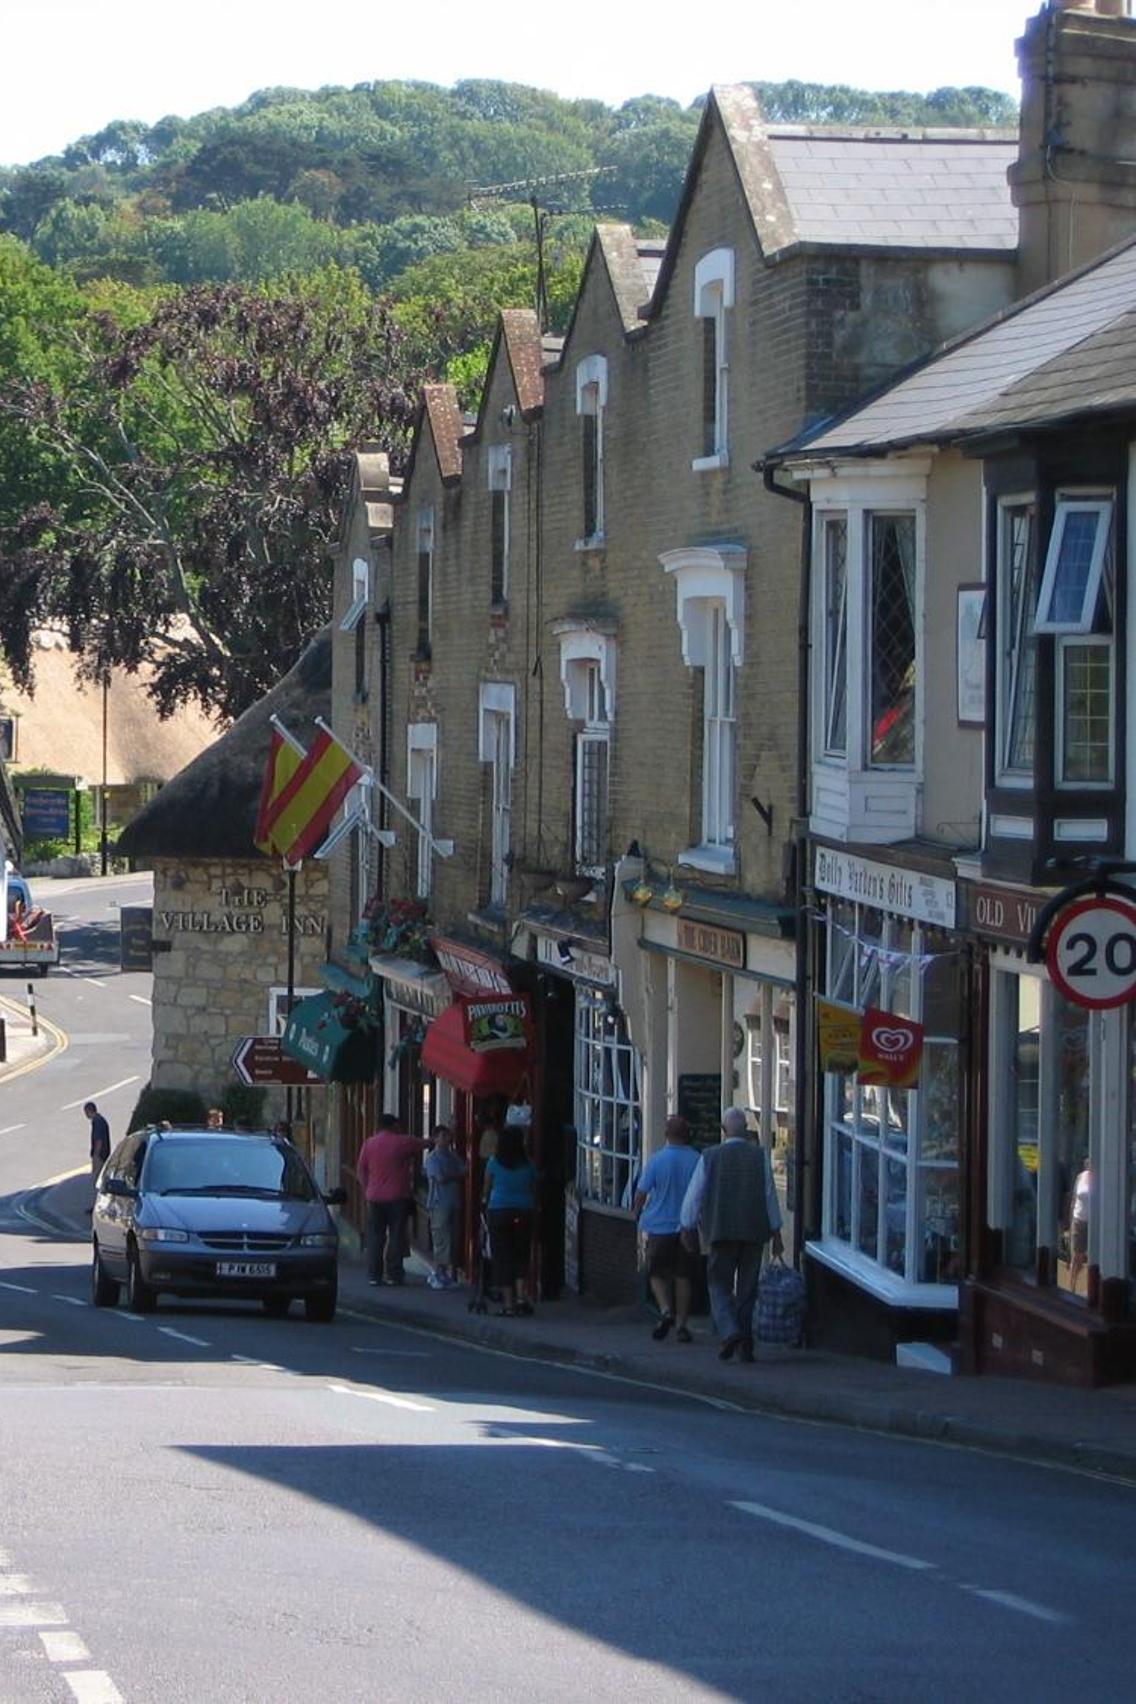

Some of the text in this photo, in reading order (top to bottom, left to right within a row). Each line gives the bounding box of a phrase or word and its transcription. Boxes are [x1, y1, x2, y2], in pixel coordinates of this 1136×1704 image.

[161, 911, 327, 935] VILLAGE INN
[976, 896, 1004, 928] OLD
[1065, 931, 1136, 977] 20
